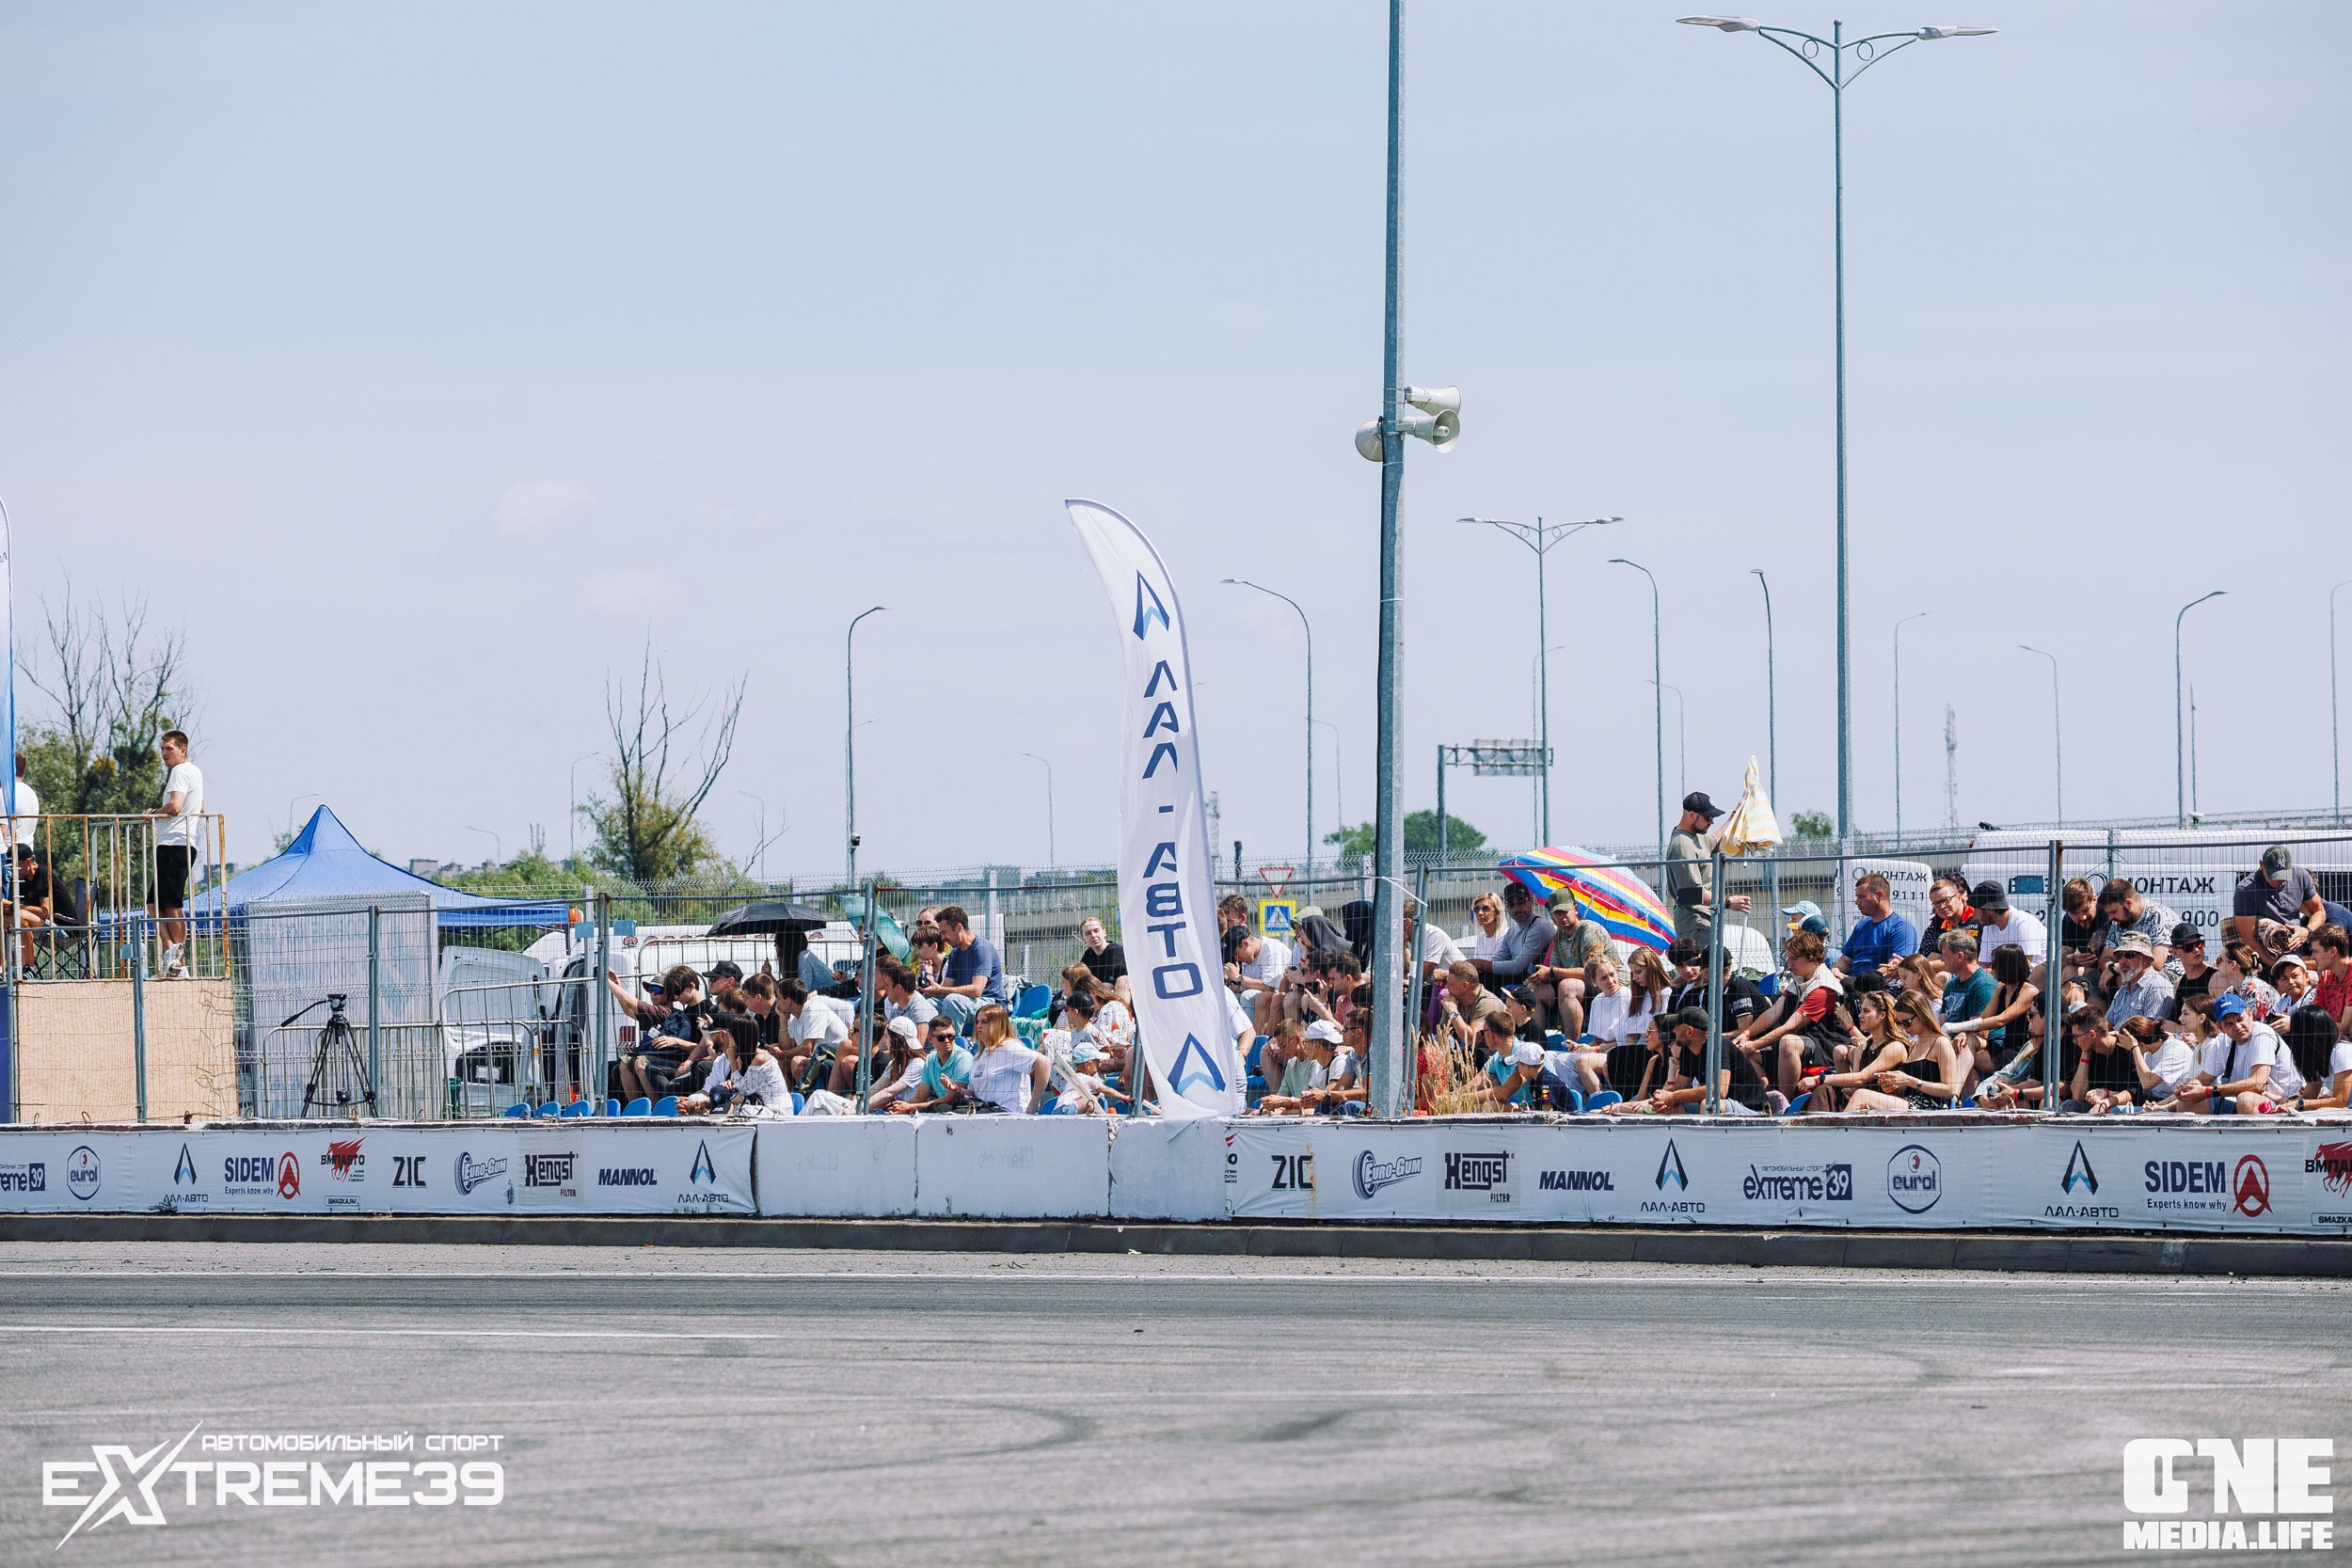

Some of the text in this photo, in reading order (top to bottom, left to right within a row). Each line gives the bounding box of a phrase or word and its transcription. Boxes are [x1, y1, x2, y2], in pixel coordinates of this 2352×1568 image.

[1870, 870, 1927, 882] ОНТАЖ
[2127, 877, 2216, 895] ОНТАЖ
[320, 1153, 365, 1166] ВМПАВТО
[524, 1150, 576, 1187] Hengst
[2304, 1159, 2352, 1174] ВМПА
[70, 1165, 98, 1182] eurol
[224, 1157, 275, 1182] SIDEM
[391, 1156, 428, 1188] ZIC
[597, 1167, 658, 1186] MANNOL
[1271, 1154, 1315, 1192] ZIC
[1444, 1149, 1510, 1191] Hengst
[2144, 1160, 2227, 1194] SIDEM
[1538, 1170, 1614, 1192] MANNOL
[1892, 1169, 1937, 1191] eurol
[225, 1185, 274, 1196] Experts know why
[560, 1188, 577, 1197] FILTER
[1489, 1193, 1511, 1203] FILTER
[2147, 1197, 2227, 1212] Experts know why
